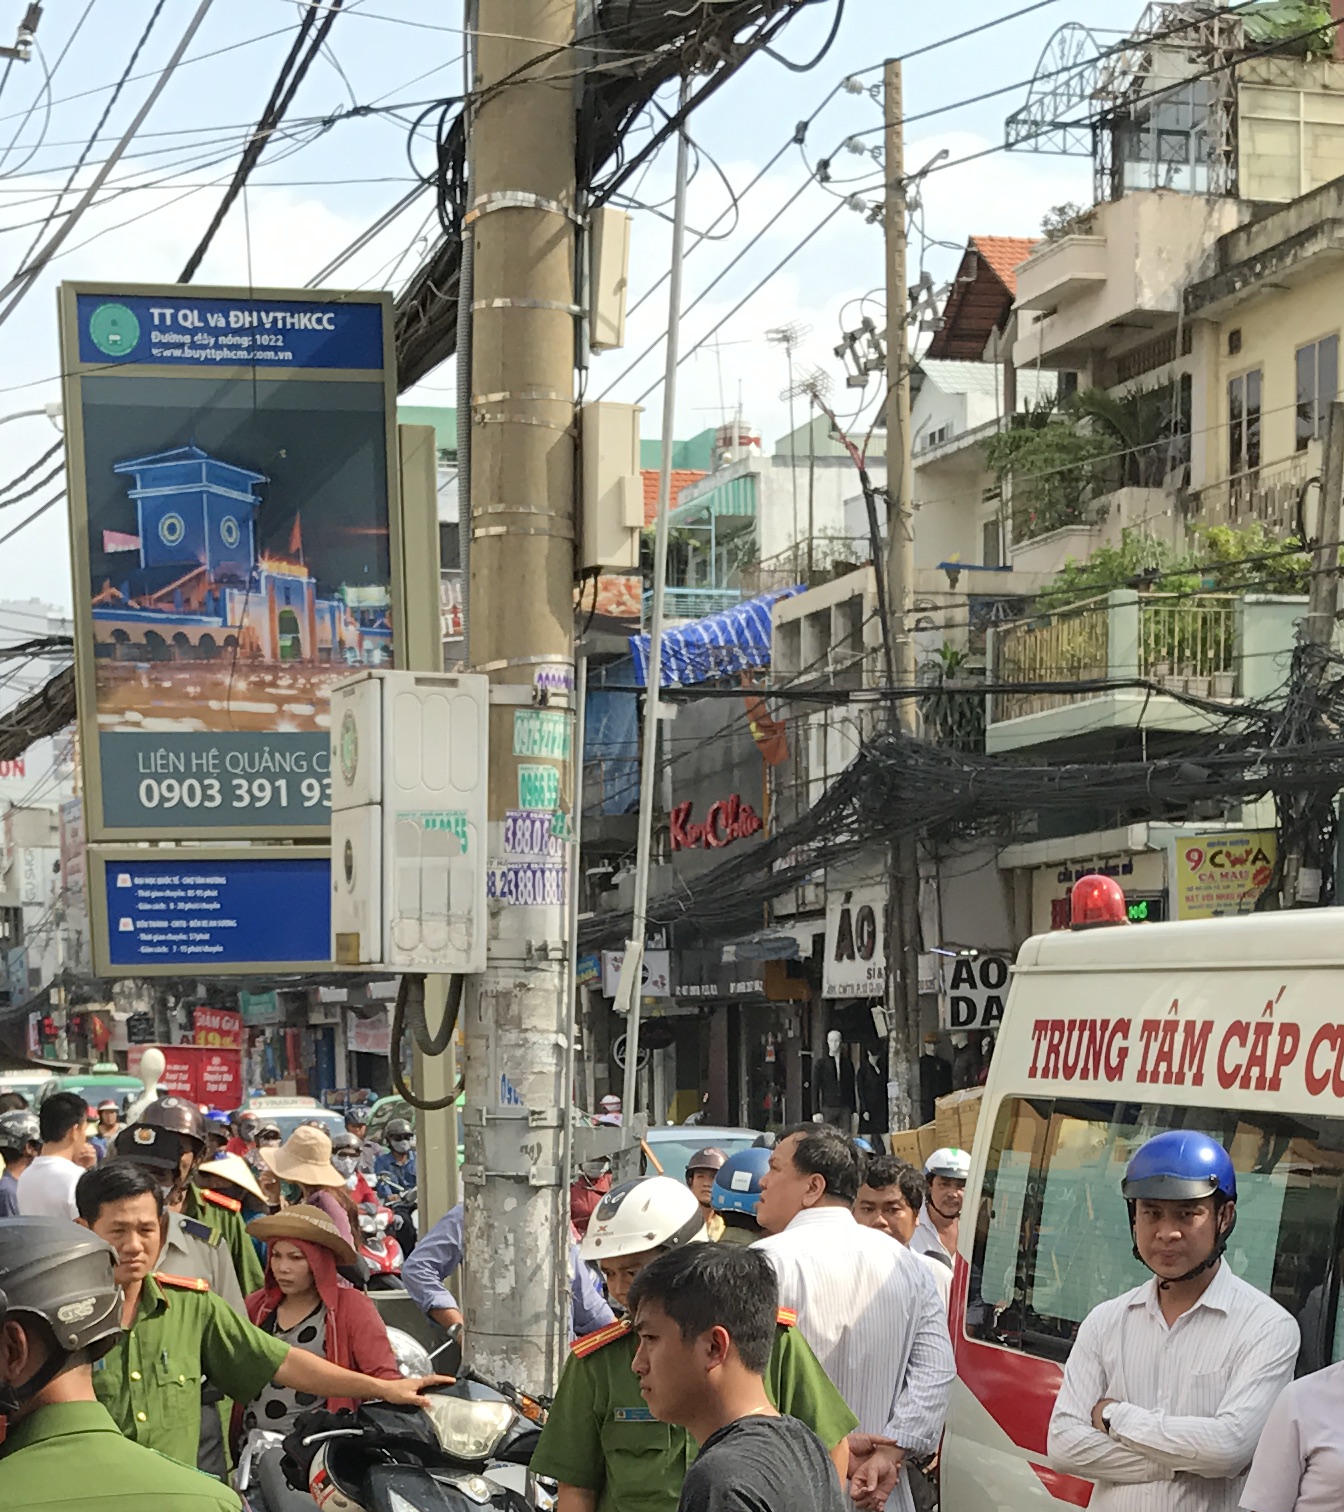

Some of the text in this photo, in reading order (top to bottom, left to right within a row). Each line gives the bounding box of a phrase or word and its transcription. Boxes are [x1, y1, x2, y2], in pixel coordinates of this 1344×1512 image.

[150, 308, 335, 330] TT QL và ĐH VTHKCC
[255, 334, 284, 346] 1022
[138, 746, 331, 777] LIÊN HỆ QUẢNG C
[139, 778, 223, 808] 0903
[231, 778, 288, 807] 391
[1185, 848, 1204, 872] 9
[834, 891, 877, 963] ÁO
[950, 954, 1008, 991] ÁO
[1027, 1018, 1133, 1080] TRUNG
[1136, 999, 1215, 1088] TÂM
[1217, 985, 1301, 1092] CẤP
